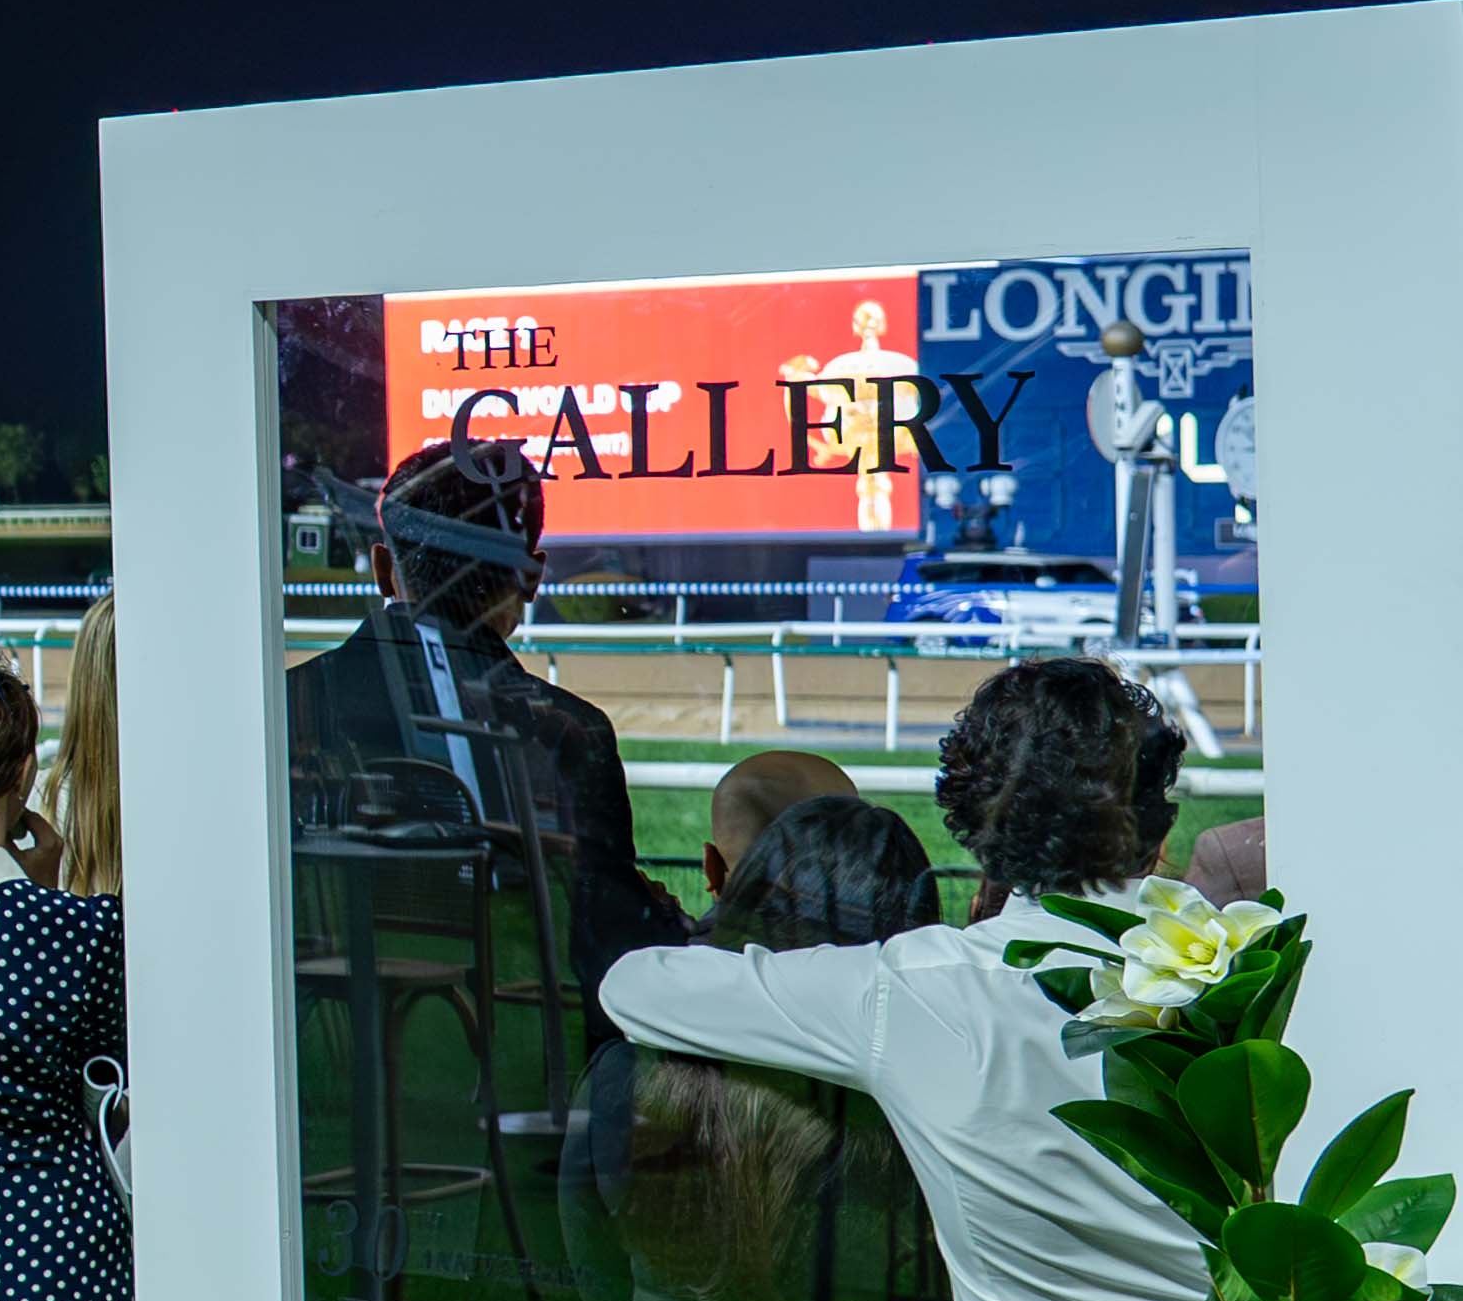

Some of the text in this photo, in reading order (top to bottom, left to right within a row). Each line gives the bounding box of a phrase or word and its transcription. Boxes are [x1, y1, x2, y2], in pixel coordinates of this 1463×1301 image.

[421, 317, 508, 354] RACE
[444, 326, 558, 371] THE
[450, 371, 1035, 485] GALLERY
